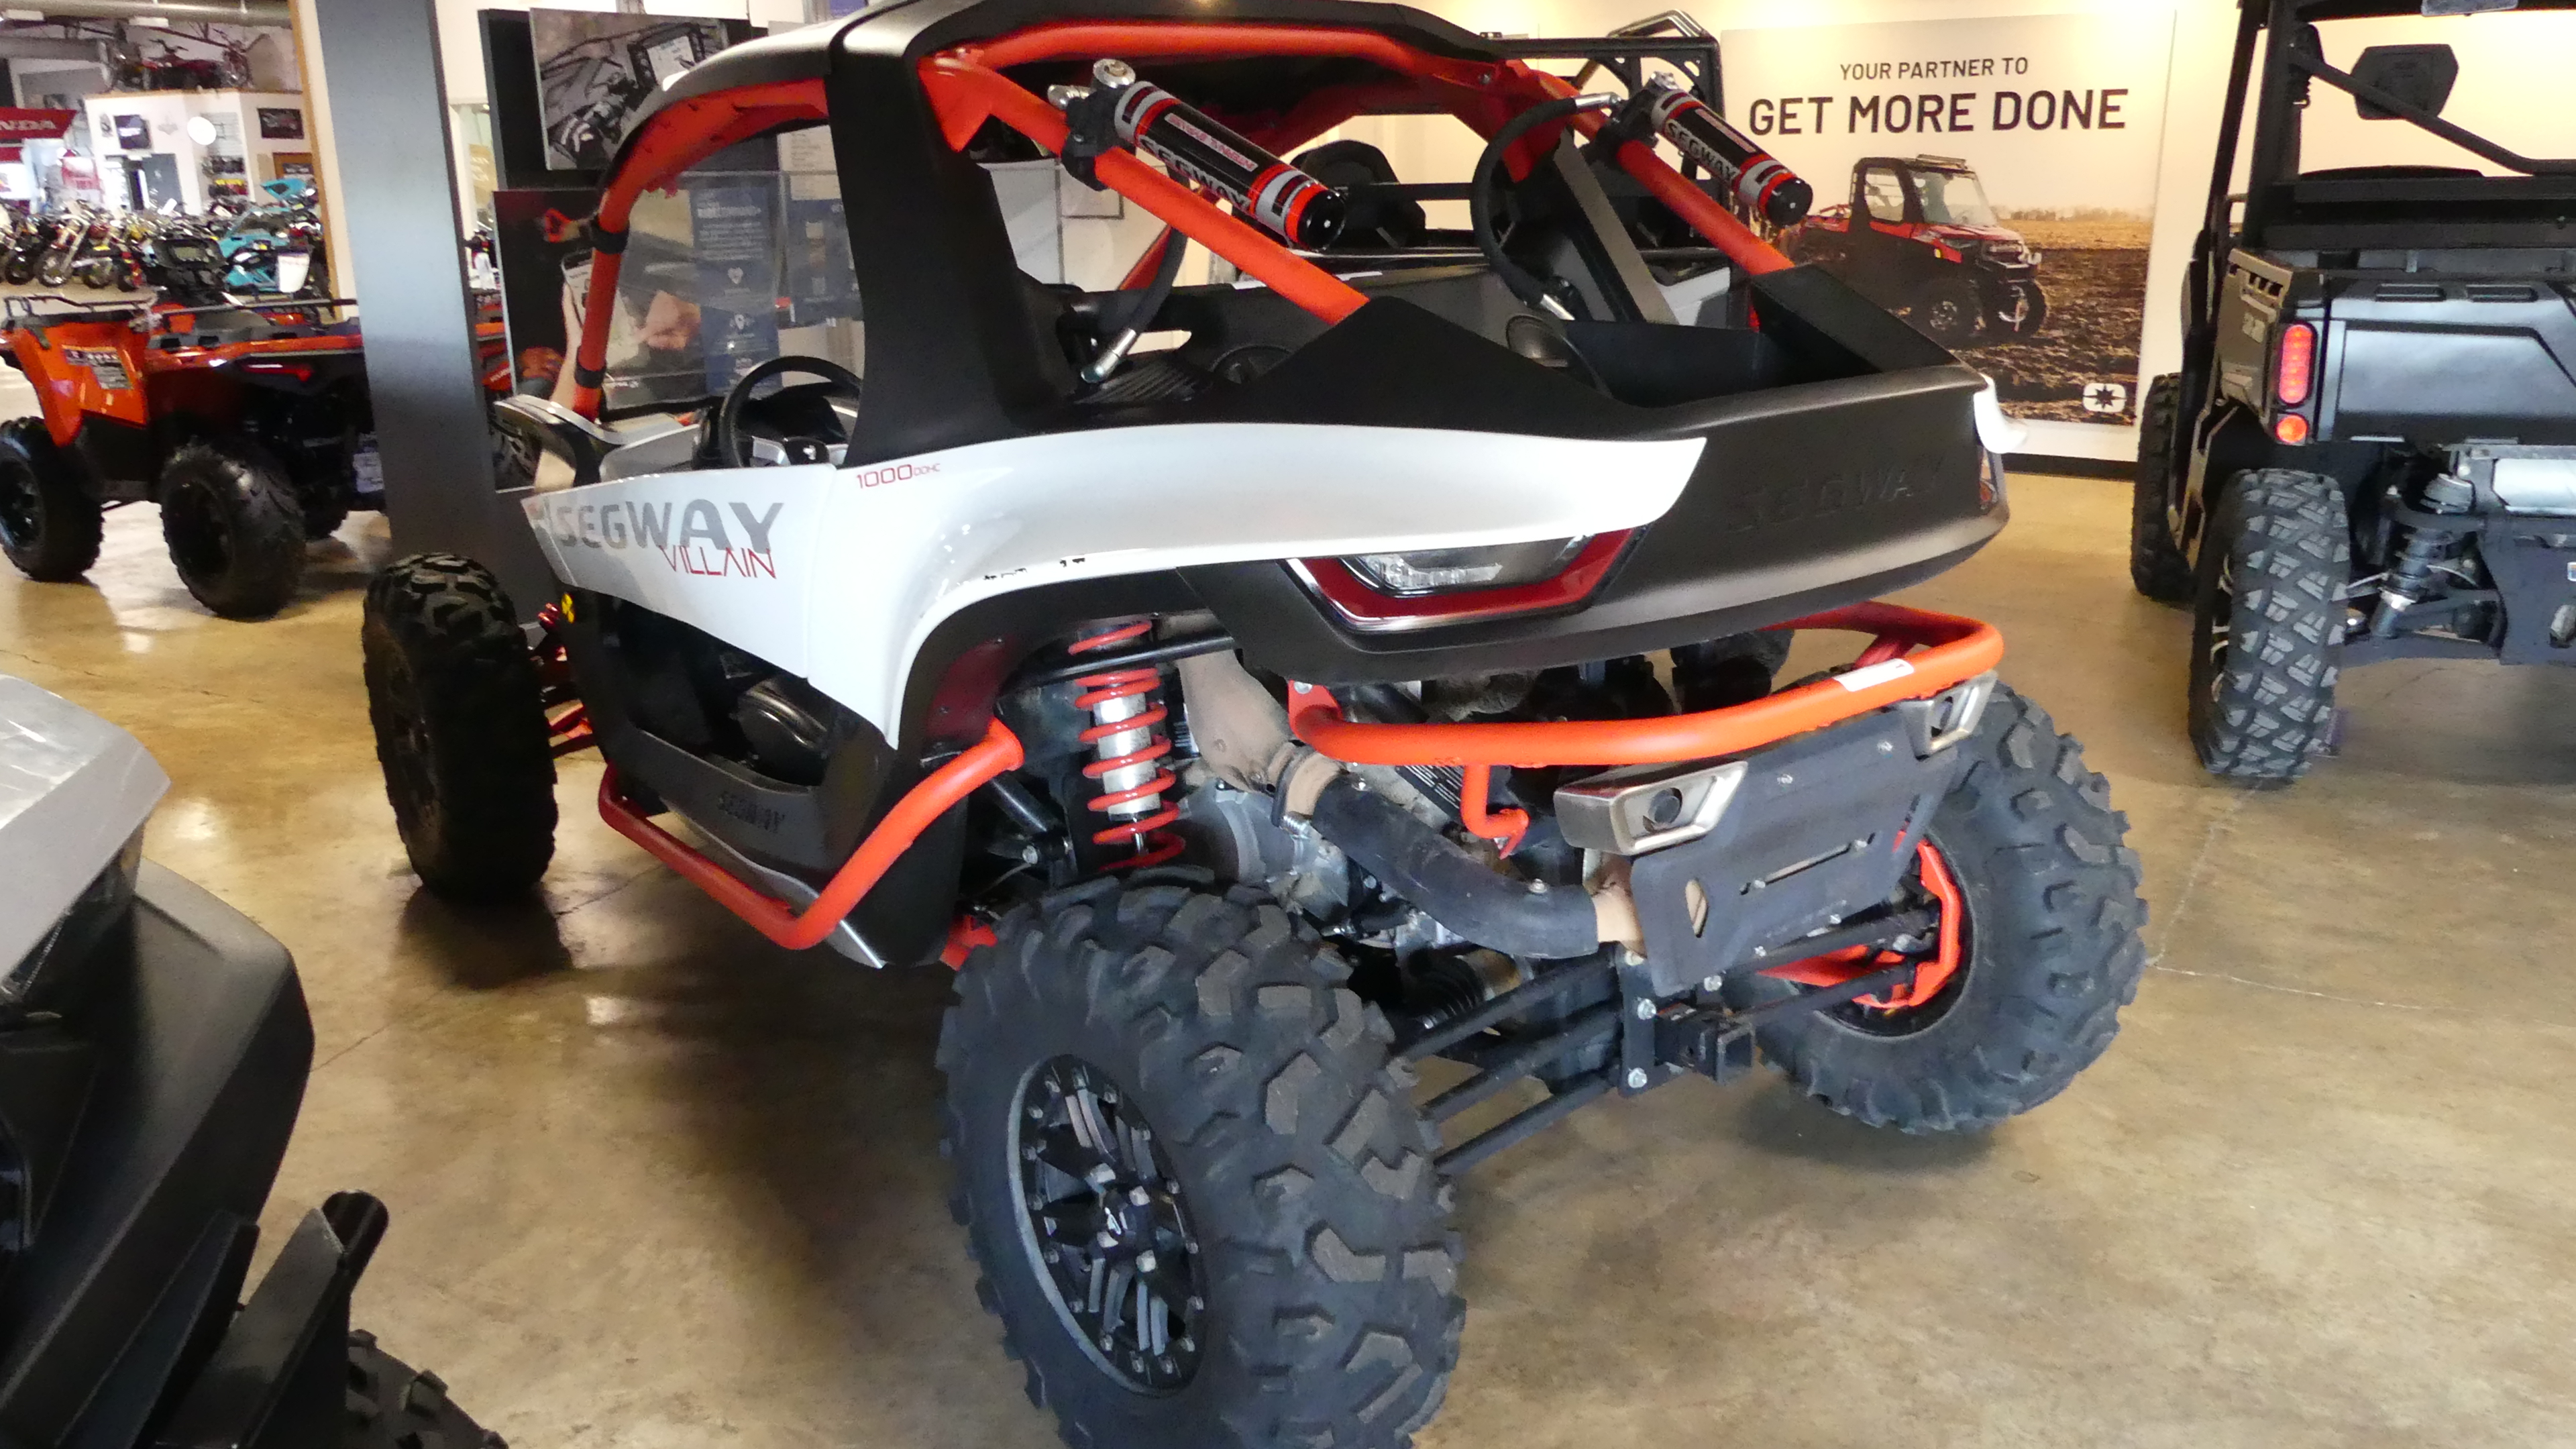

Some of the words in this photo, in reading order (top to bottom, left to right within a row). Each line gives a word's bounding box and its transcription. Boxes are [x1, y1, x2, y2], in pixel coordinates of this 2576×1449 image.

[1840, 62, 1891, 80] YOUR
[1898, 58, 1994, 79] PARTNER
[2002, 57, 2029, 74] TO
[1749, 97, 1833, 136] GET
[1848, 93, 1976, 133] MORE
[1992, 89, 2129, 130] DONE
[857, 464, 913, 489] 1000
[555, 498, 784, 555] SEGWAY
[659, 545, 777, 579] VILLAIN
